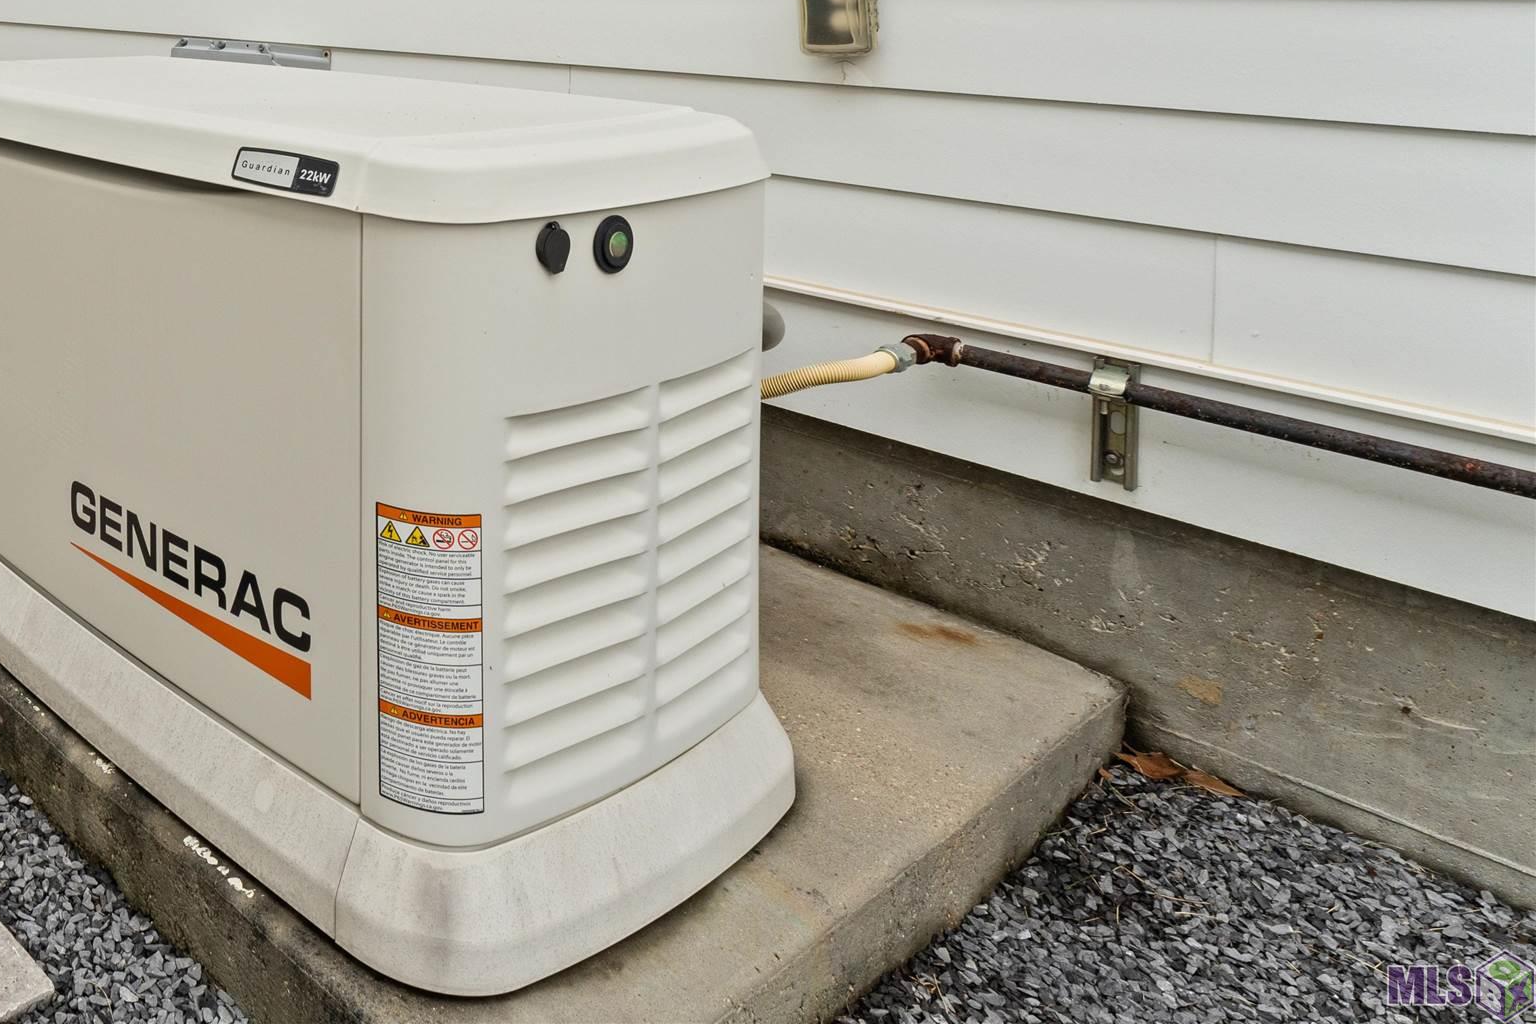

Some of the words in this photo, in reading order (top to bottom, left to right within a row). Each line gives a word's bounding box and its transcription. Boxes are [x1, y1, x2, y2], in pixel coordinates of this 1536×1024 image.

[241, 160, 291, 176] Guardian
[299, 168, 332, 184] 22kW
[412, 514, 462, 526] WARNING
[70, 480, 311, 653] GENERAC
[394, 613, 479, 630] AVERTISSEMENT
[402, 710, 475, 726] ADVERTENCIA
